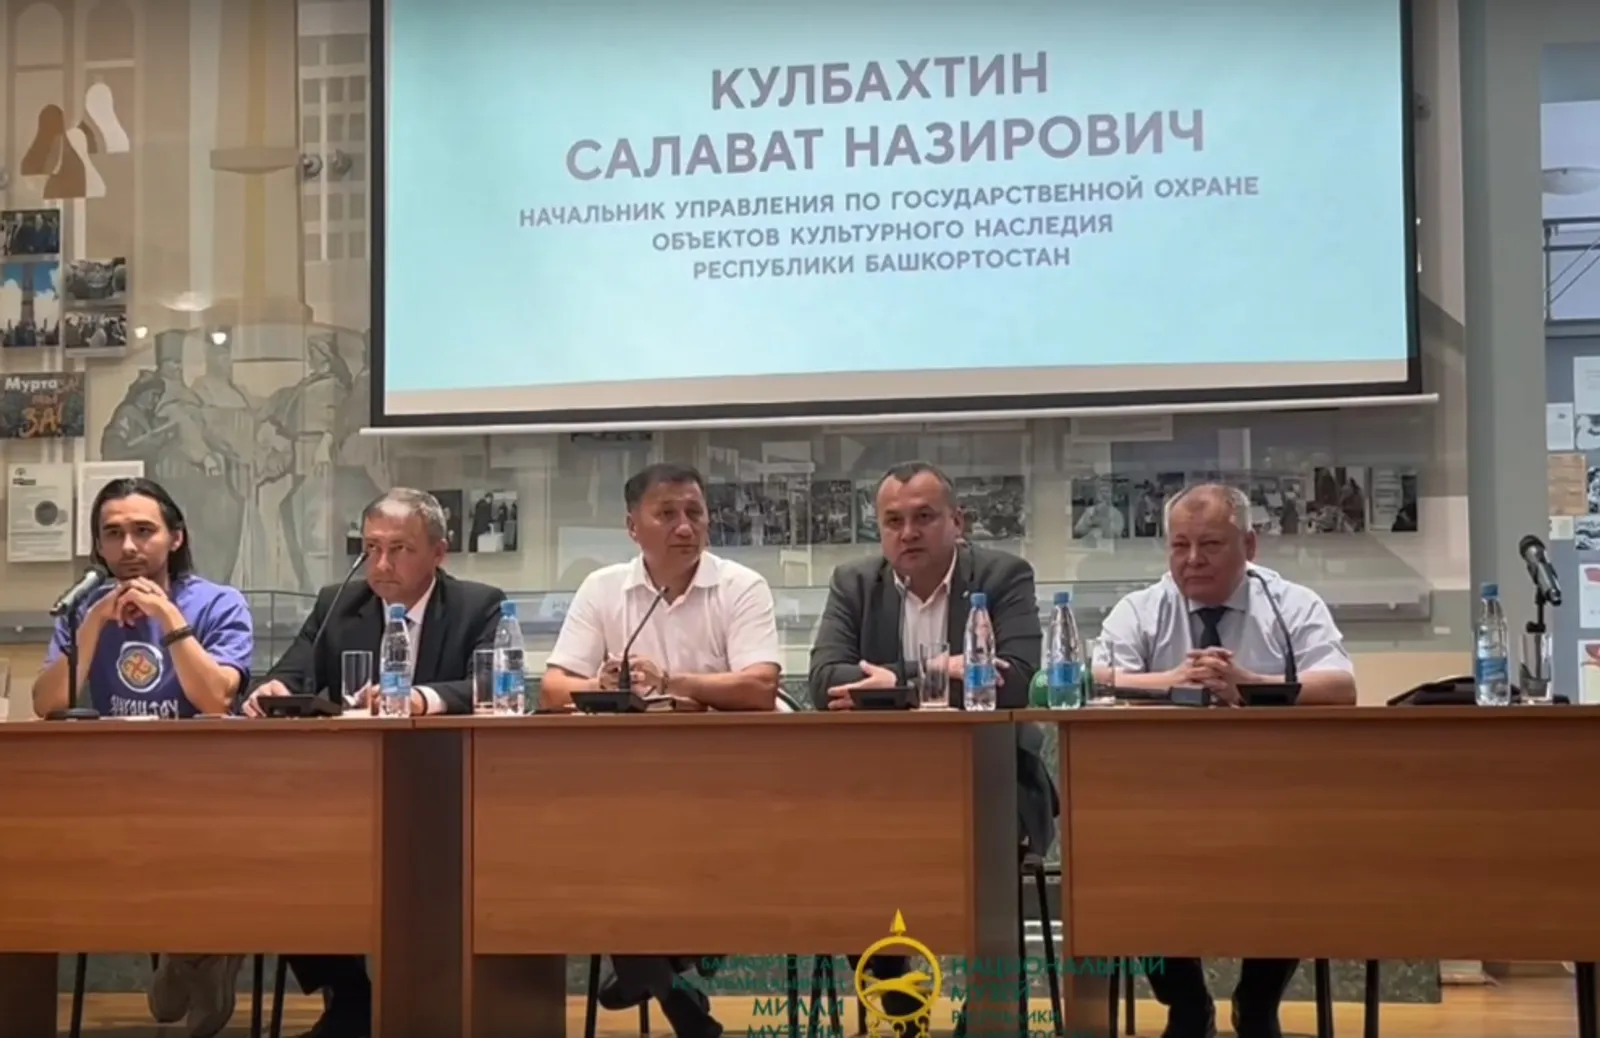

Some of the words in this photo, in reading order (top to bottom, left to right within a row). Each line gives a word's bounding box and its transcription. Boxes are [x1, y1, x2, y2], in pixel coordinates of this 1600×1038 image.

[711, 51, 1047, 110] КУЛБАХТИН
[566, 128, 824, 181] САЛАВАТ
[845, 109, 1204, 168] НАЗИРОВИЧ
[519, 202, 665, 227] НАЧАЛЬНИК
[675, 195, 834, 219] УПРАВЛЕНИЯ
[845, 193, 881, 212] ПО
[891, 175, 1143, 210] ГОСУДАРСТВЕННОЙ
[1154, 176, 1260, 199] ОХРАНЕ
[652, 228, 780, 252] ОБЪЕКТОВ
[791, 220, 965, 246] КУЛЬТУРНОГО
[975, 214, 1114, 238] НАСЛЕДИЯ
[693, 256, 854, 280] РЕСПУБЛИКИ
[866, 248, 1070, 274] БАШКОРТОСТАН
